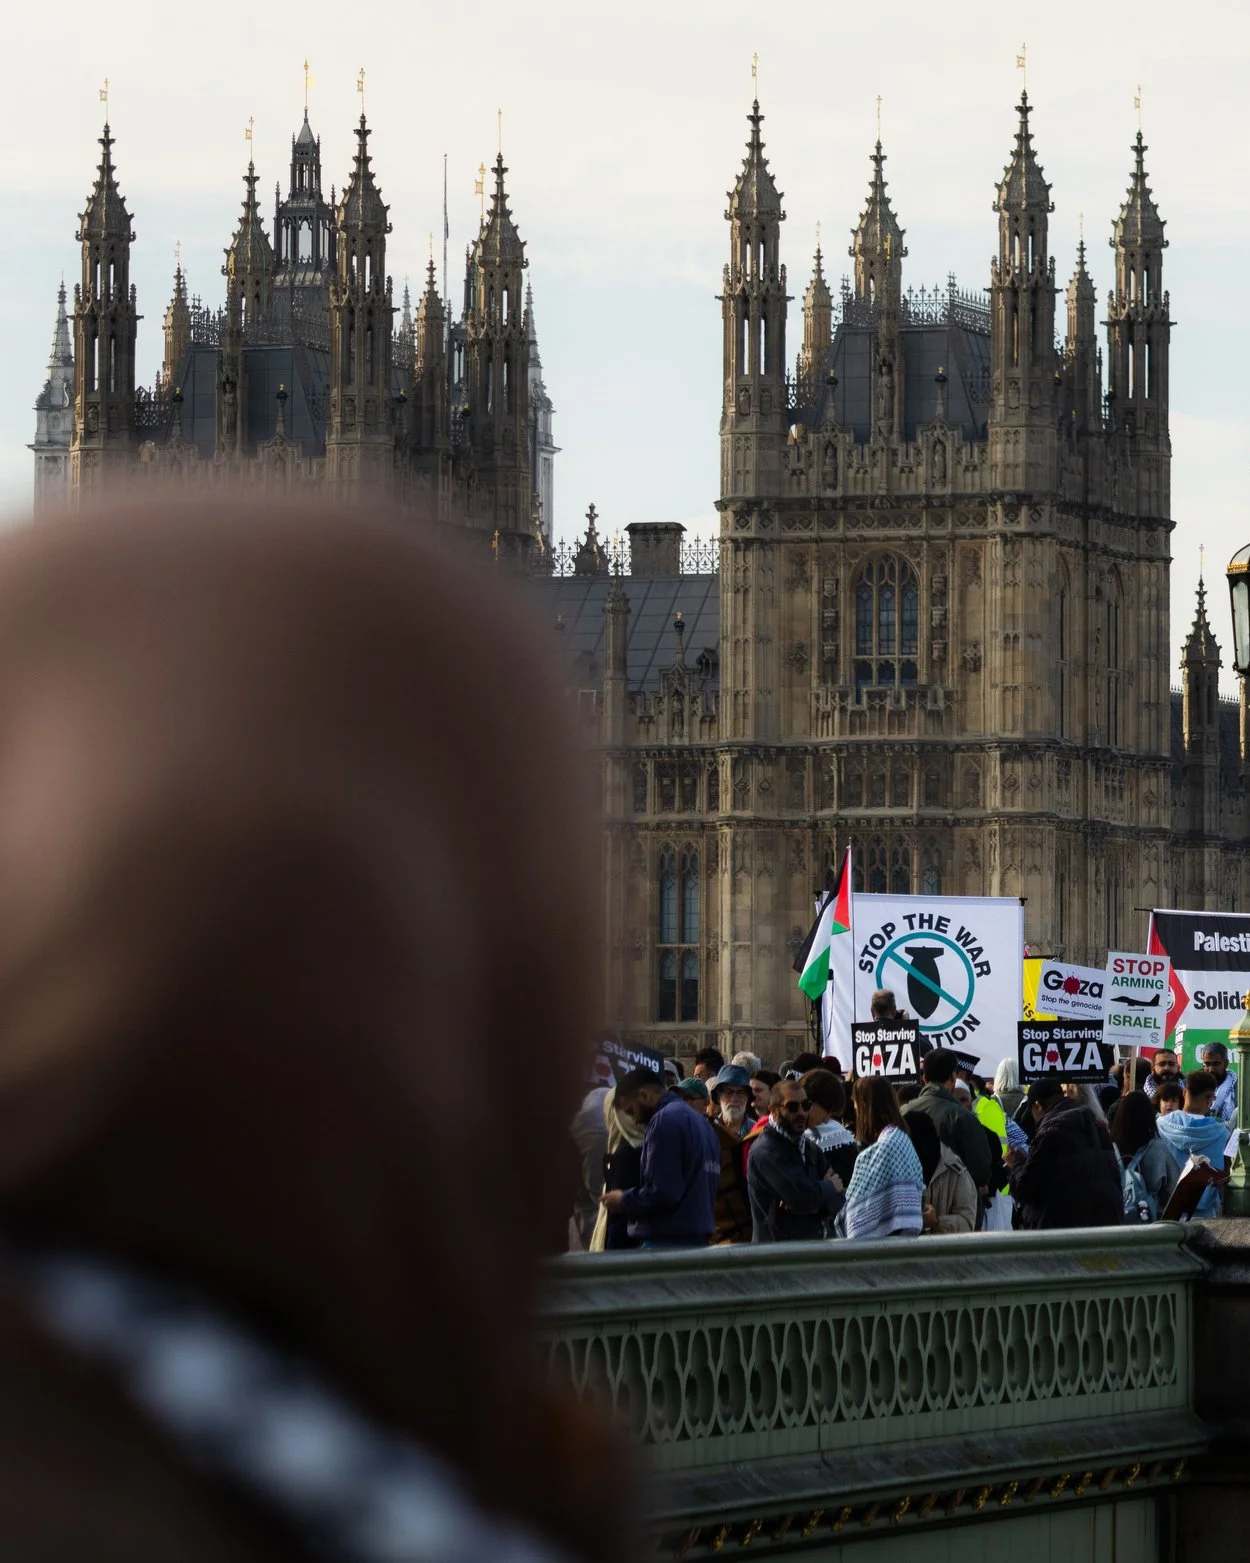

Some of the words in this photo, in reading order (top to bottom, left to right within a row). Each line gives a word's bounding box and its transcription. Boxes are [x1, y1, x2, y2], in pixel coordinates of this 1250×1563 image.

[858, 922, 897, 974] STOP
[903, 912, 951, 934] THE
[955, 925, 992, 979] WAR
[1112, 958, 1165, 976] STOP
[1043, 969, 1104, 999] Gza
[1111, 975, 1164, 990] ARMING
[1041, 994, 1057, 1004] Stop
[1058, 996, 1070, 1006] the
[1071, 1000, 1103, 1011] genocide
[925, 1013, 981, 1049] TION
[1108, 1013, 1161, 1030] ISRAEL
[855, 1029, 876, 1045] Stop
[877, 1027, 916, 1043] Starving
[1022, 1028, 1050, 1042] Stop
[1052, 1026, 1103, 1041] Starving
[603, 1040, 660, 1073] Starving
[855, 1043, 917, 1078] GAZA
[1022, 1042, 1104, 1072] GAZA
